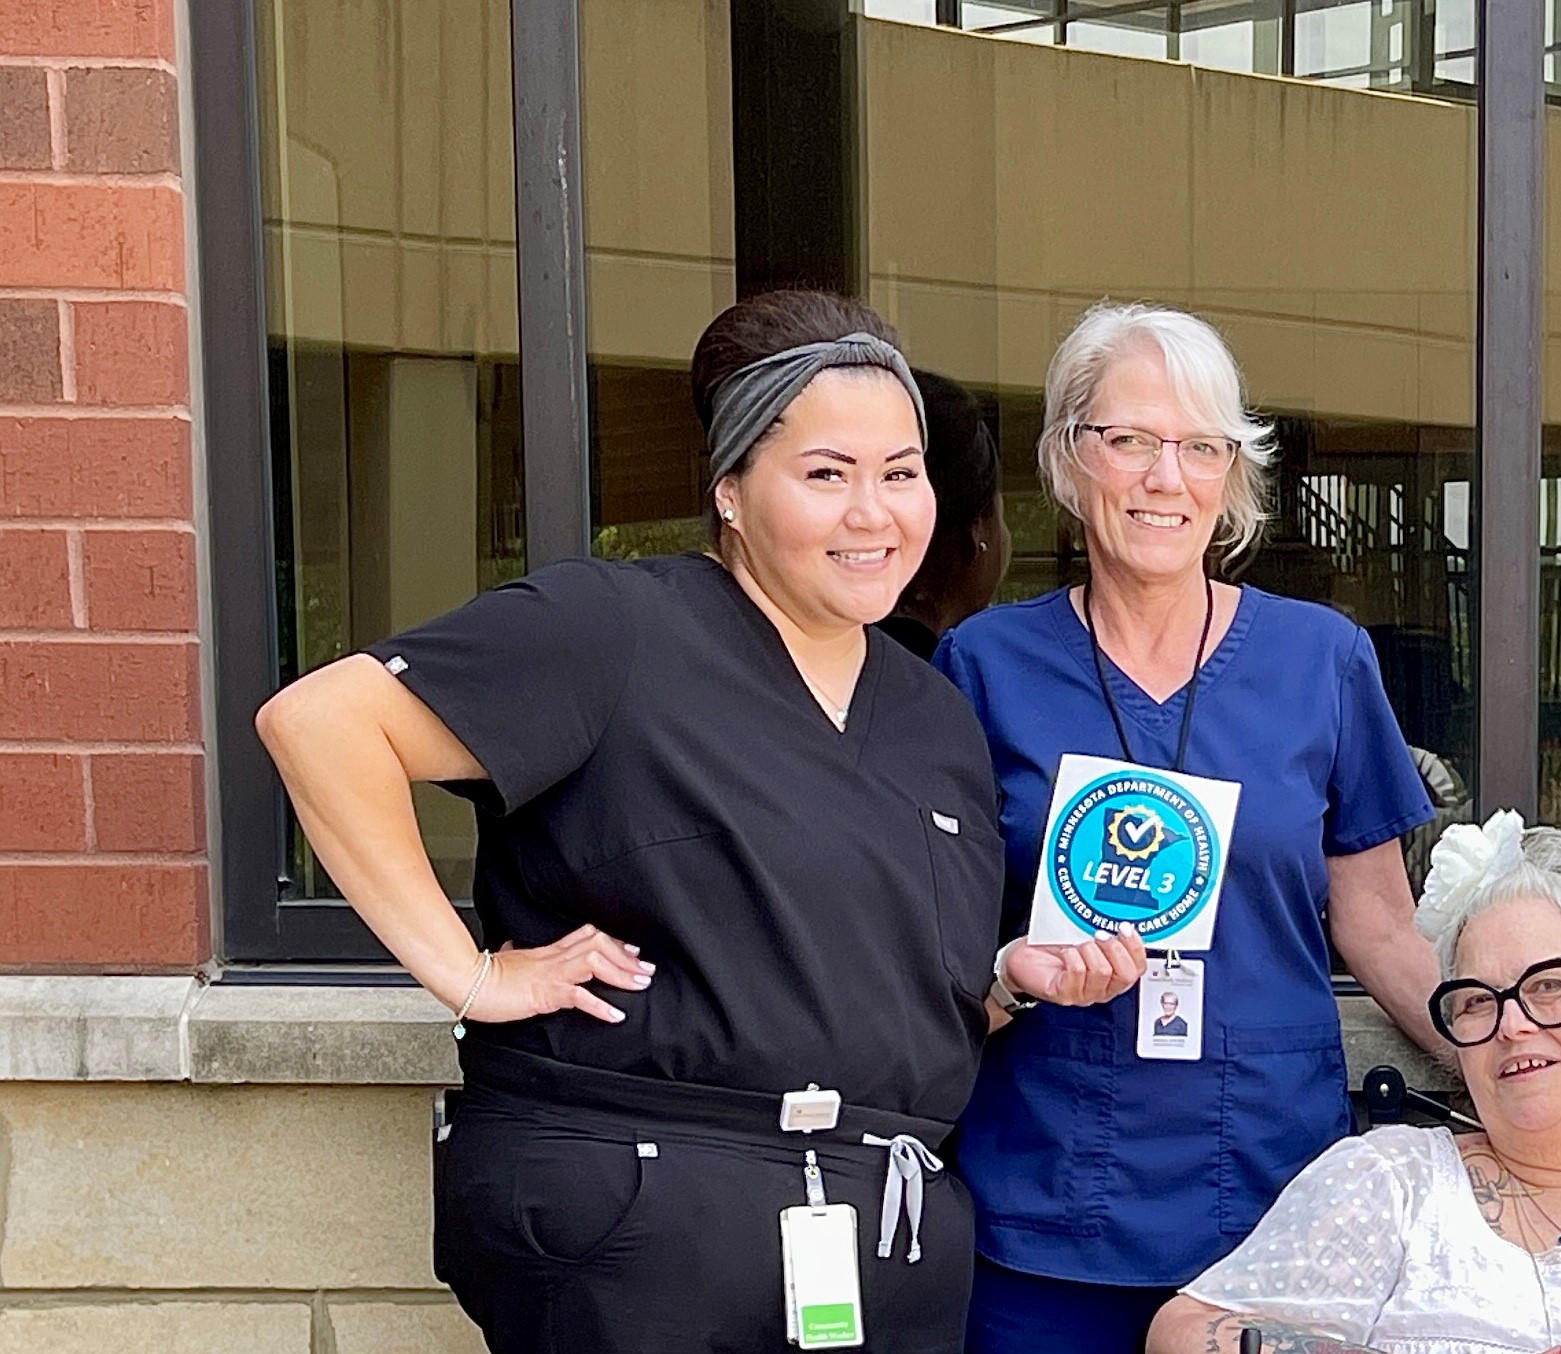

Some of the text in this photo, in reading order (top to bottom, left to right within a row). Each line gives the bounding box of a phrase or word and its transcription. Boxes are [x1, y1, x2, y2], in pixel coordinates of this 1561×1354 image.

[1058, 782, 1210, 871] MINNESOTA DEPARTMENT OF HEALTH
[1058, 867, 1200, 933] CERTIFIED HEAL CARE HOME
[1082, 860, 1177, 894] LEVEL 3
